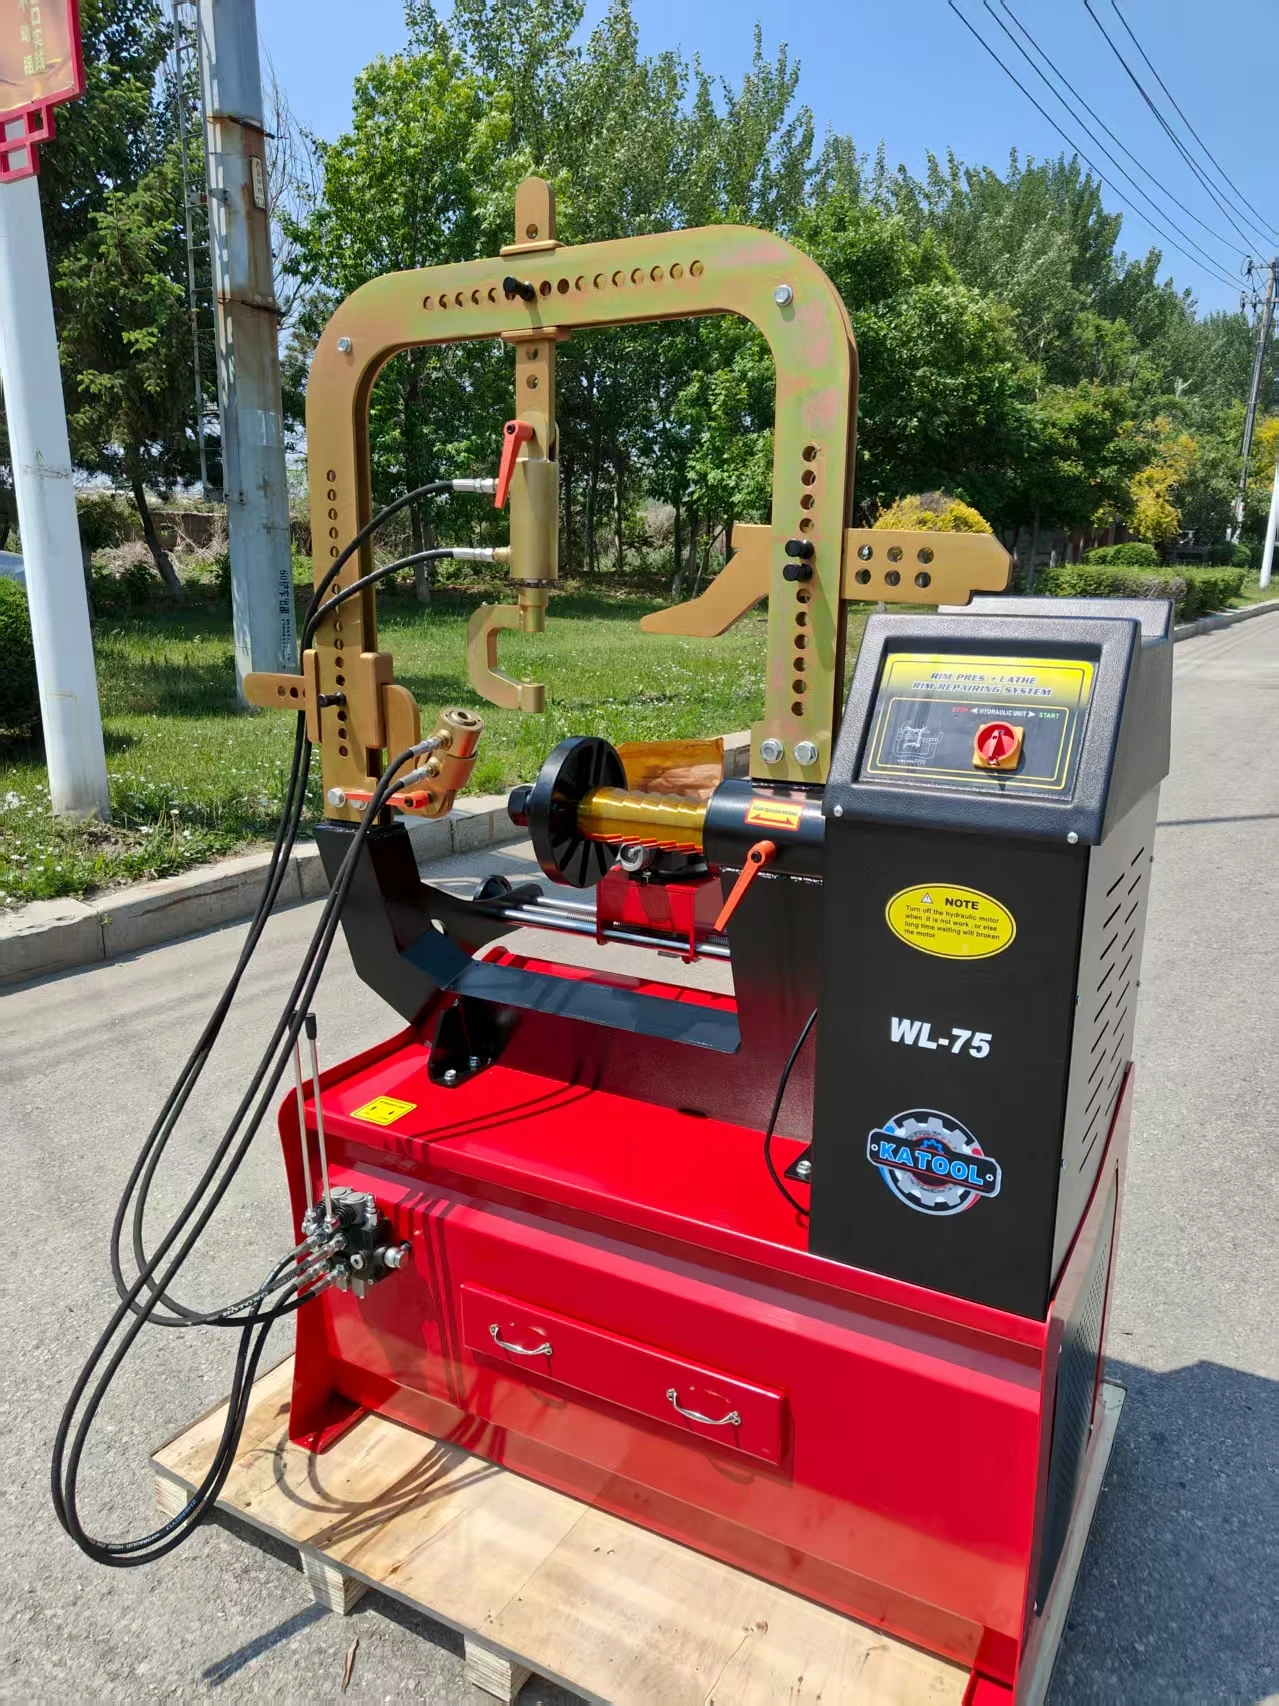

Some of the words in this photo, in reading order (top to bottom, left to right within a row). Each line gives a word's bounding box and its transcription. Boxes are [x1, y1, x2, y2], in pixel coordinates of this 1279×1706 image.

[930, 672, 952, 680] RIM
[956, 673, 985, 681] PRES
[1000, 675, 1036, 684] LATHE
[937, 683, 1000, 693] REPAIRING
[1004, 686, 1052, 696] SYSTEM
[979, 707, 1012, 716] HYDRAULIC
[945, 897, 979, 910] NOTE
[905, 913, 922, 921] when
[940, 917, 951, 925] not
[952, 920, 969, 928] work
[983, 924, 997, 932] else
[945, 911, 977, 921] hydraulic
[979, 916, 1000, 924] motor
[904, 921, 919, 929] long
[921, 923, 935, 931] time
[937, 925, 961, 935] waiting
[976, 931, 1000, 940] broken
[916, 931, 936, 939] motor
[890, 1016, 993, 1058] WL-75
[879, 1140, 984, 1186] KATOOL
